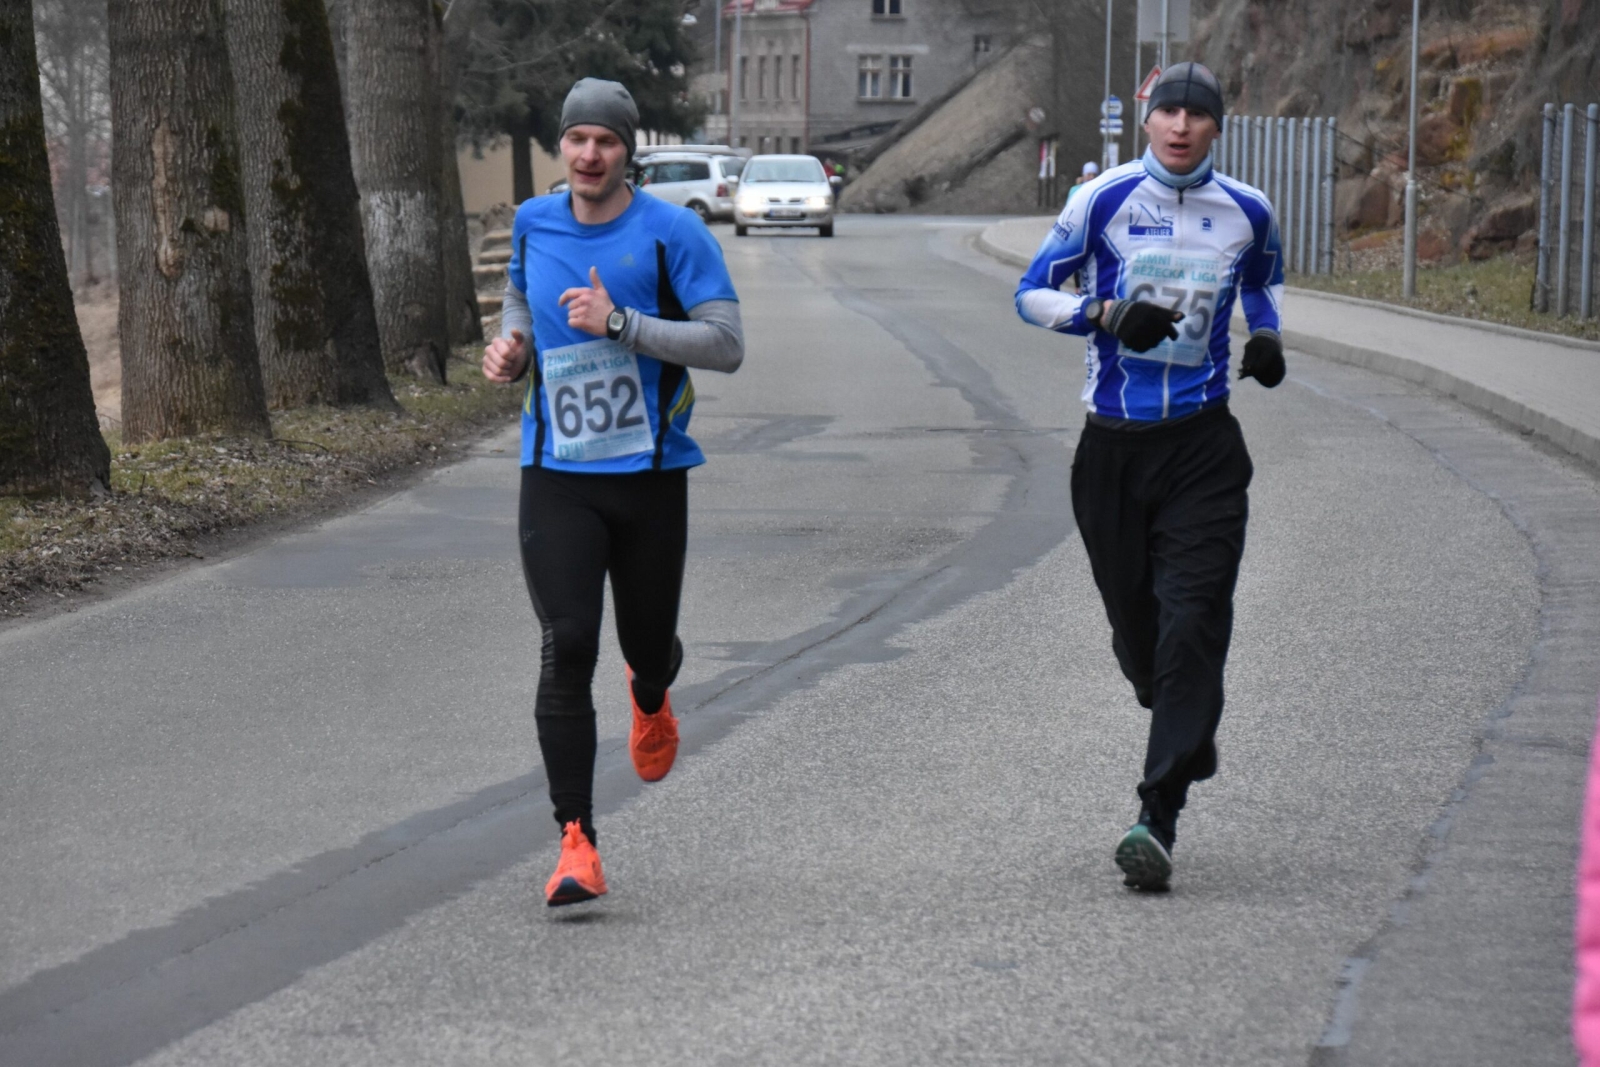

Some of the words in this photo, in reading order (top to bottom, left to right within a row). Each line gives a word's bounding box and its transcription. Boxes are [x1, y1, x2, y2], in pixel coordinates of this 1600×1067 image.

[1144, 227, 1171, 236] ATELIER
[1191, 271, 1218, 284] LIGA
[604, 354, 632, 370] LIGA
[554, 375, 645, 439] 652
